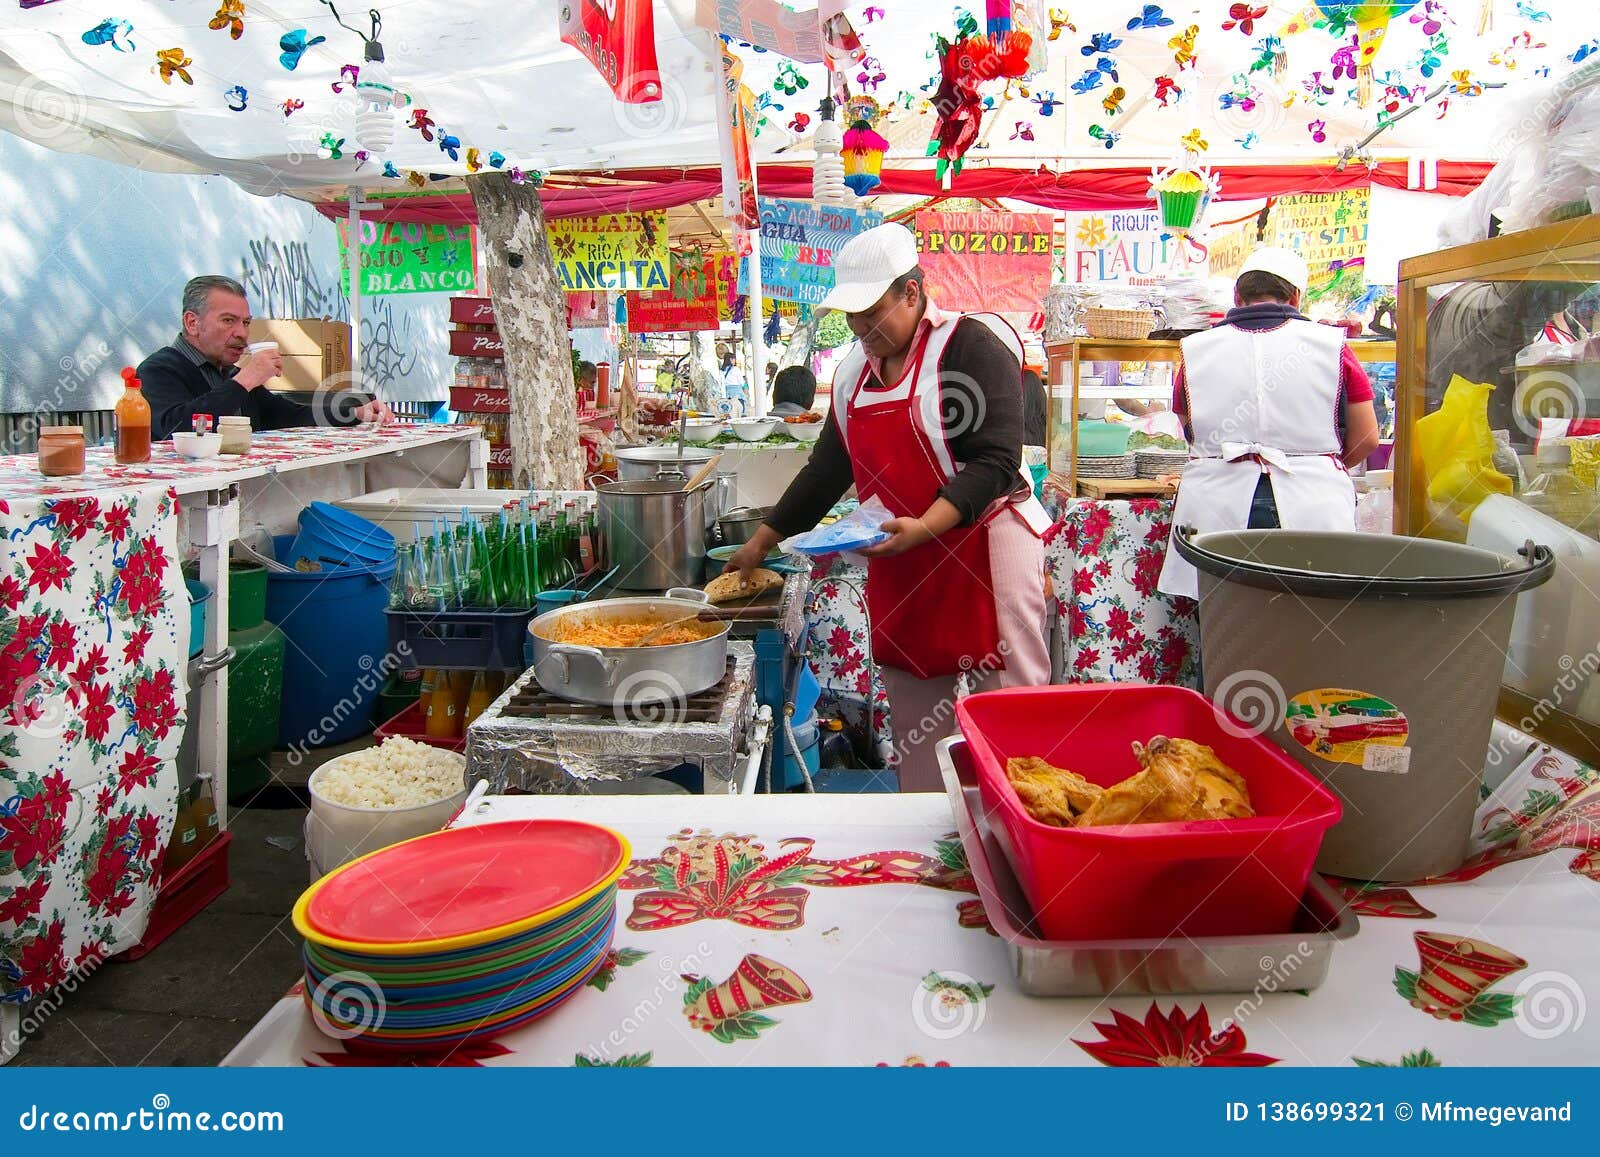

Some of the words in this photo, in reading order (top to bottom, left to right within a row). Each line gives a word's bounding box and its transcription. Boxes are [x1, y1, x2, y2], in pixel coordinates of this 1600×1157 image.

[943, 214, 1014, 230] RIQUISIMO
[760, 222, 808, 243] GUA
[588, 243, 623, 260] RICA
[929, 232, 1049, 253] POZOLE
[412, 247, 429, 265] Y
[367, 270, 471, 292] BLANCO
